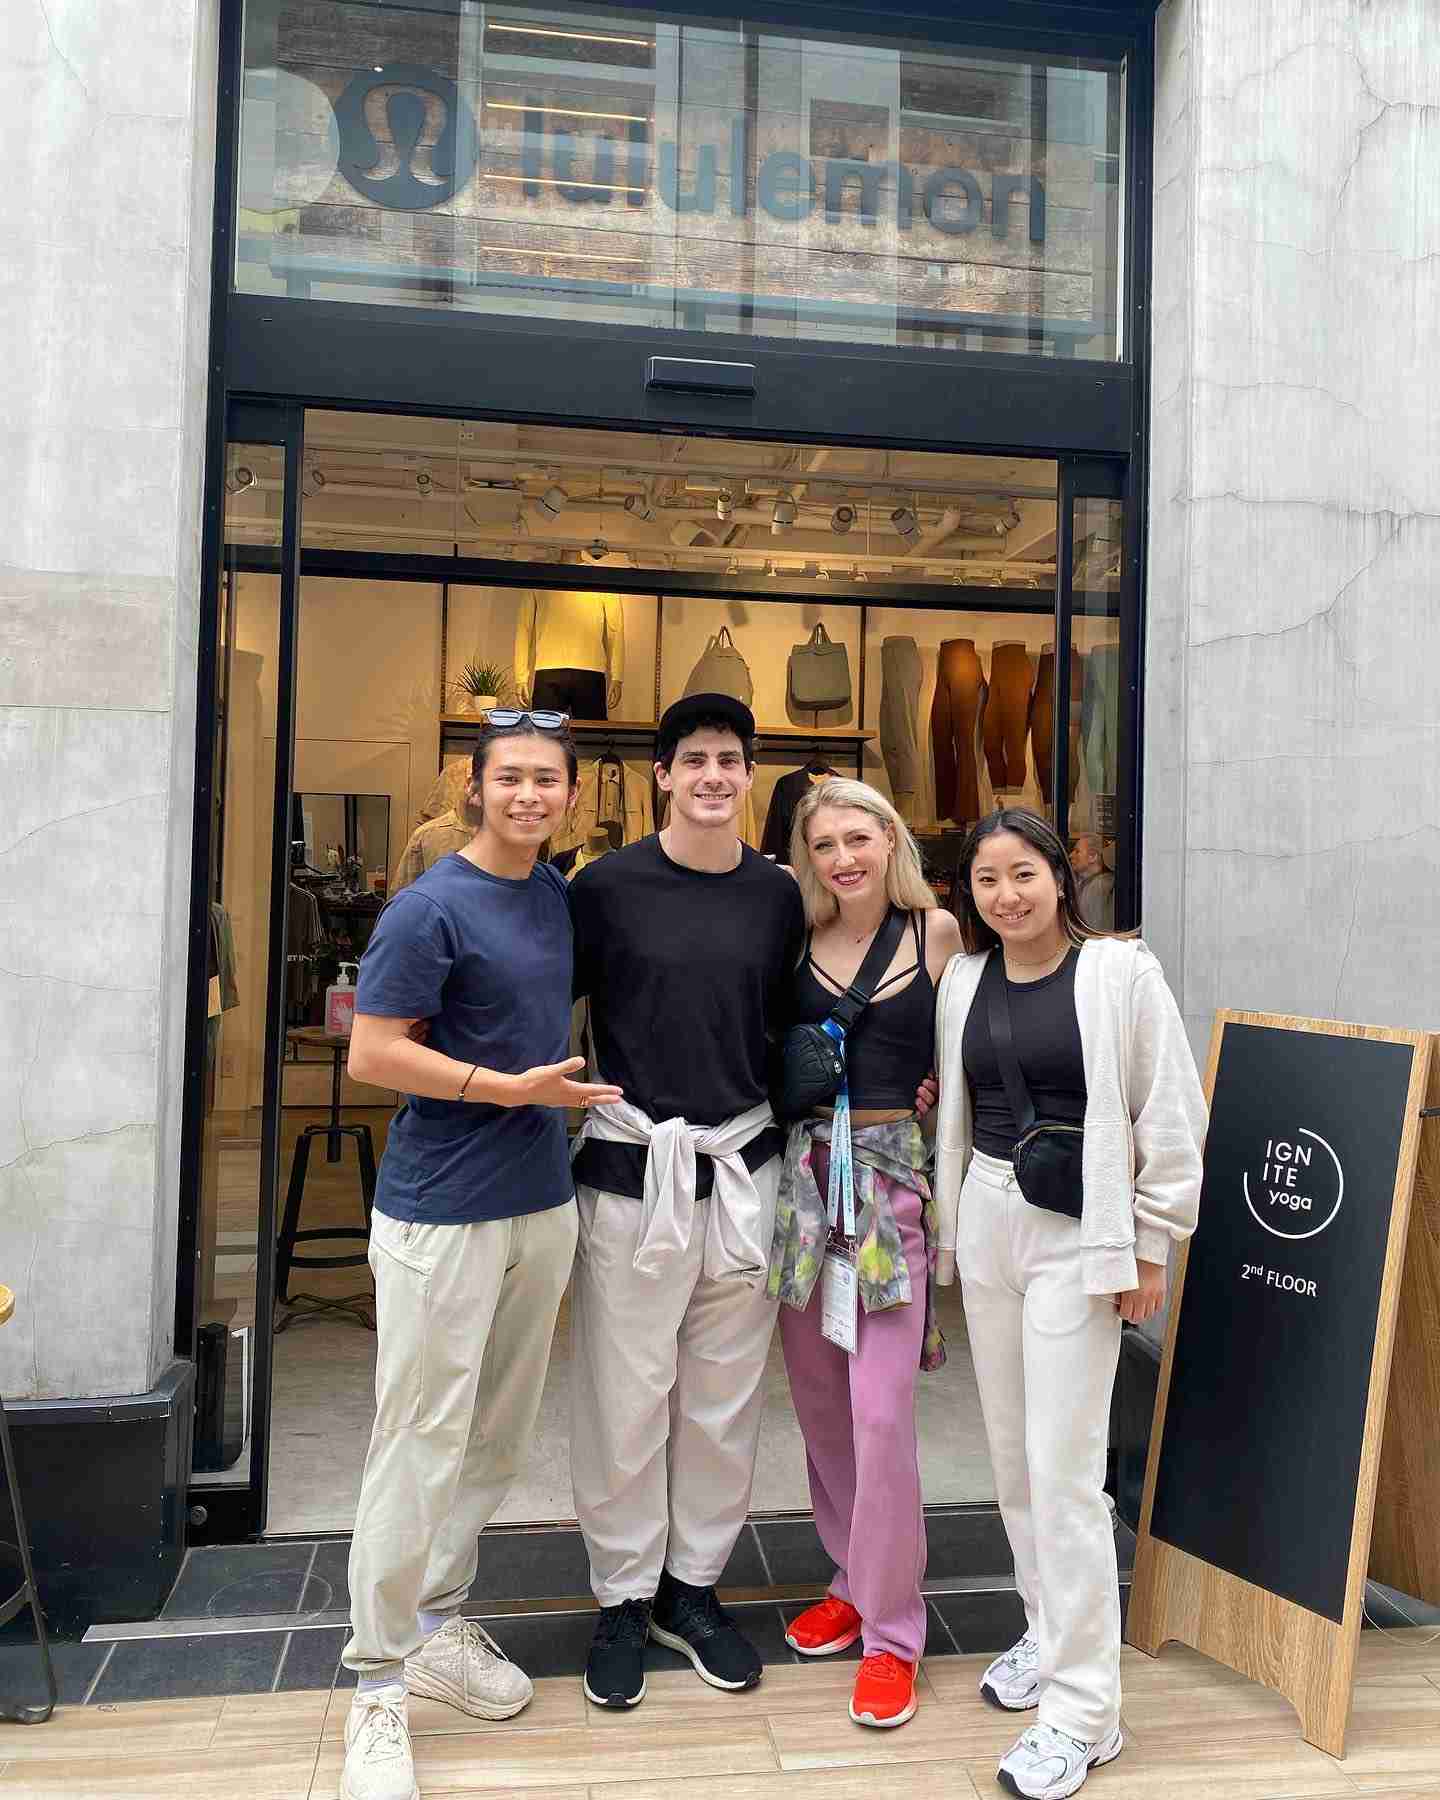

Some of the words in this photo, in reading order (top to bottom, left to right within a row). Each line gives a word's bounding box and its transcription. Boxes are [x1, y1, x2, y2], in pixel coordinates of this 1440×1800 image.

[521, 94, 1047, 241] lululemon
[1266, 1139, 1312, 1166] IGN
[1263, 1162, 1298, 1187] ITE
[1269, 1189, 1313, 1211] yoga
[1241, 1263, 1264, 1280] 2nd
[1266, 1270, 1317, 1297] FLOOR
